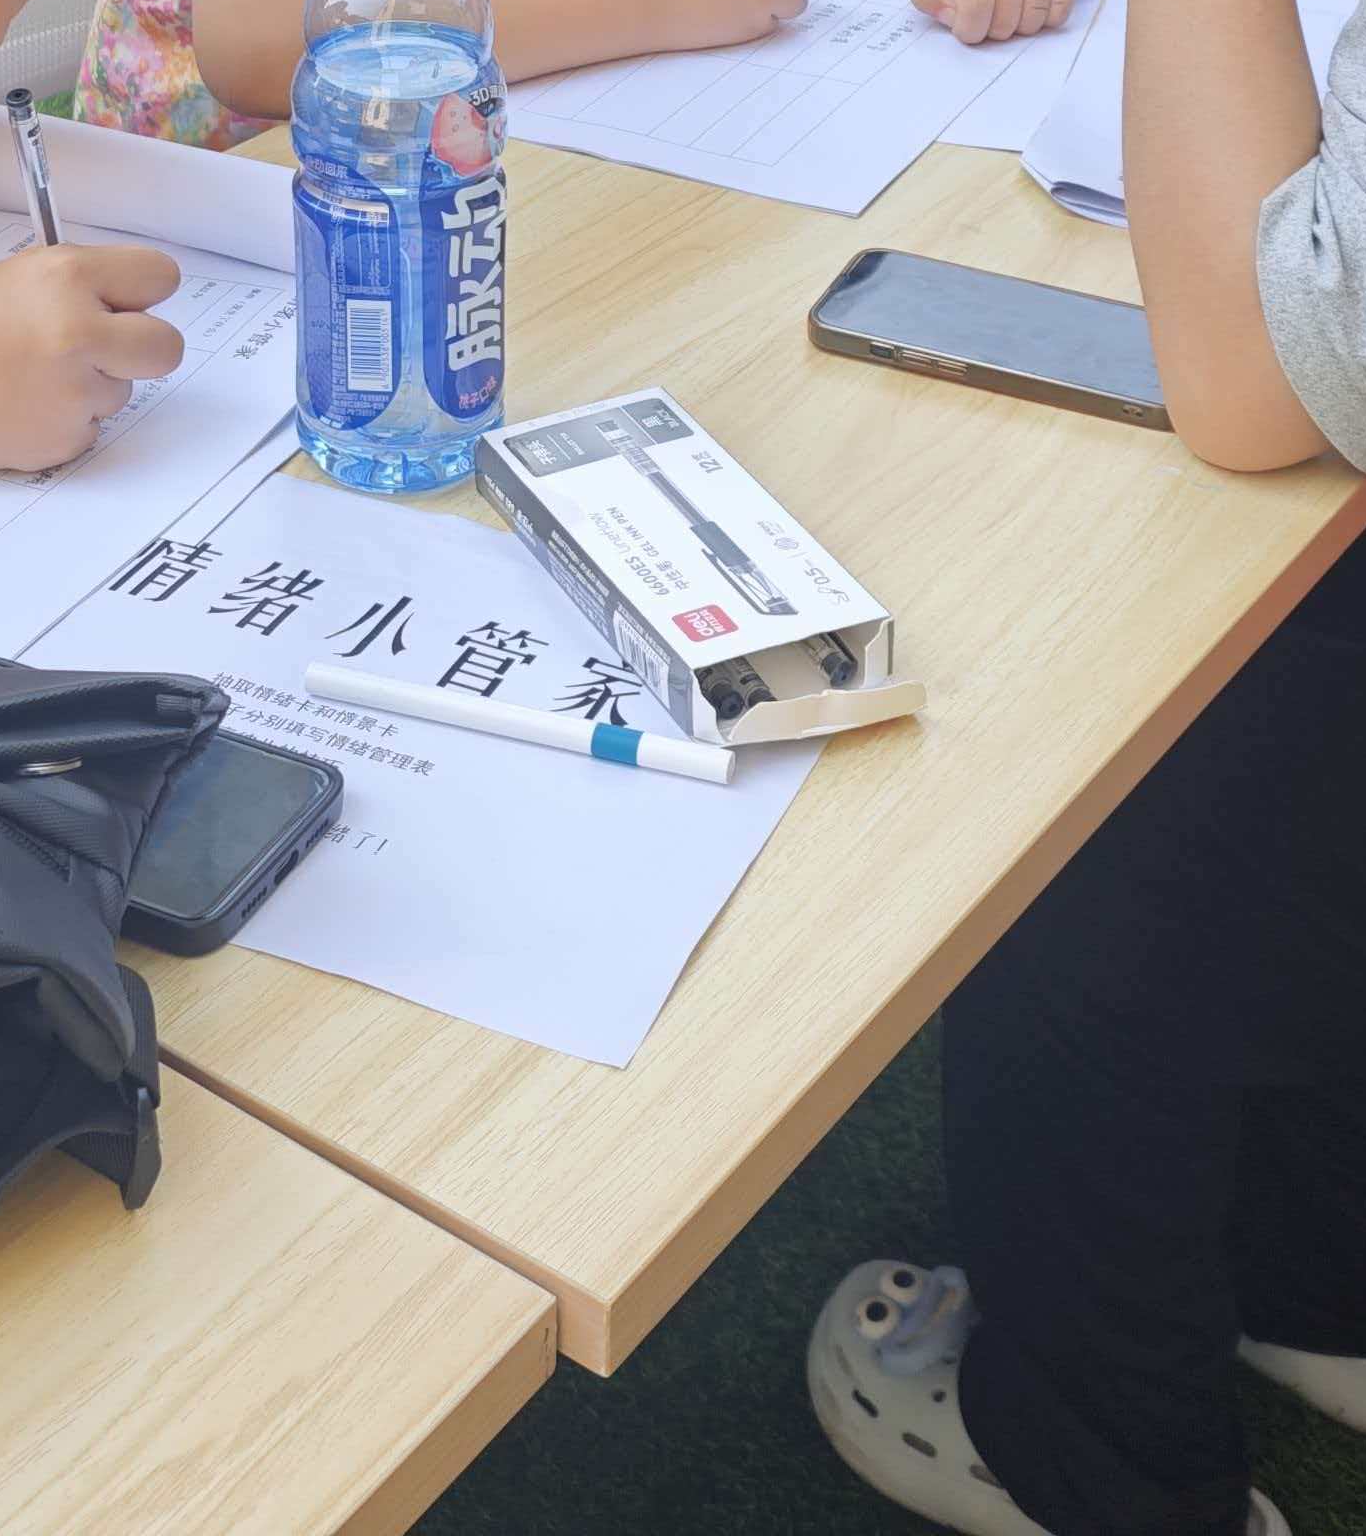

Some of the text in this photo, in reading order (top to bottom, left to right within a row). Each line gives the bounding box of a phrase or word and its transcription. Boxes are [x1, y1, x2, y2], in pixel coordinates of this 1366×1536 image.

[441, 176, 507, 372] 脉动
[232, 297, 300, 360] 绪小管家
[625, 556, 670, 596] 6600ES
[108, 537, 643, 726] 情绪小管家
[684, 612, 716, 637] deli
[211, 671, 399, 737] 抽取情绪卡和情景卡
